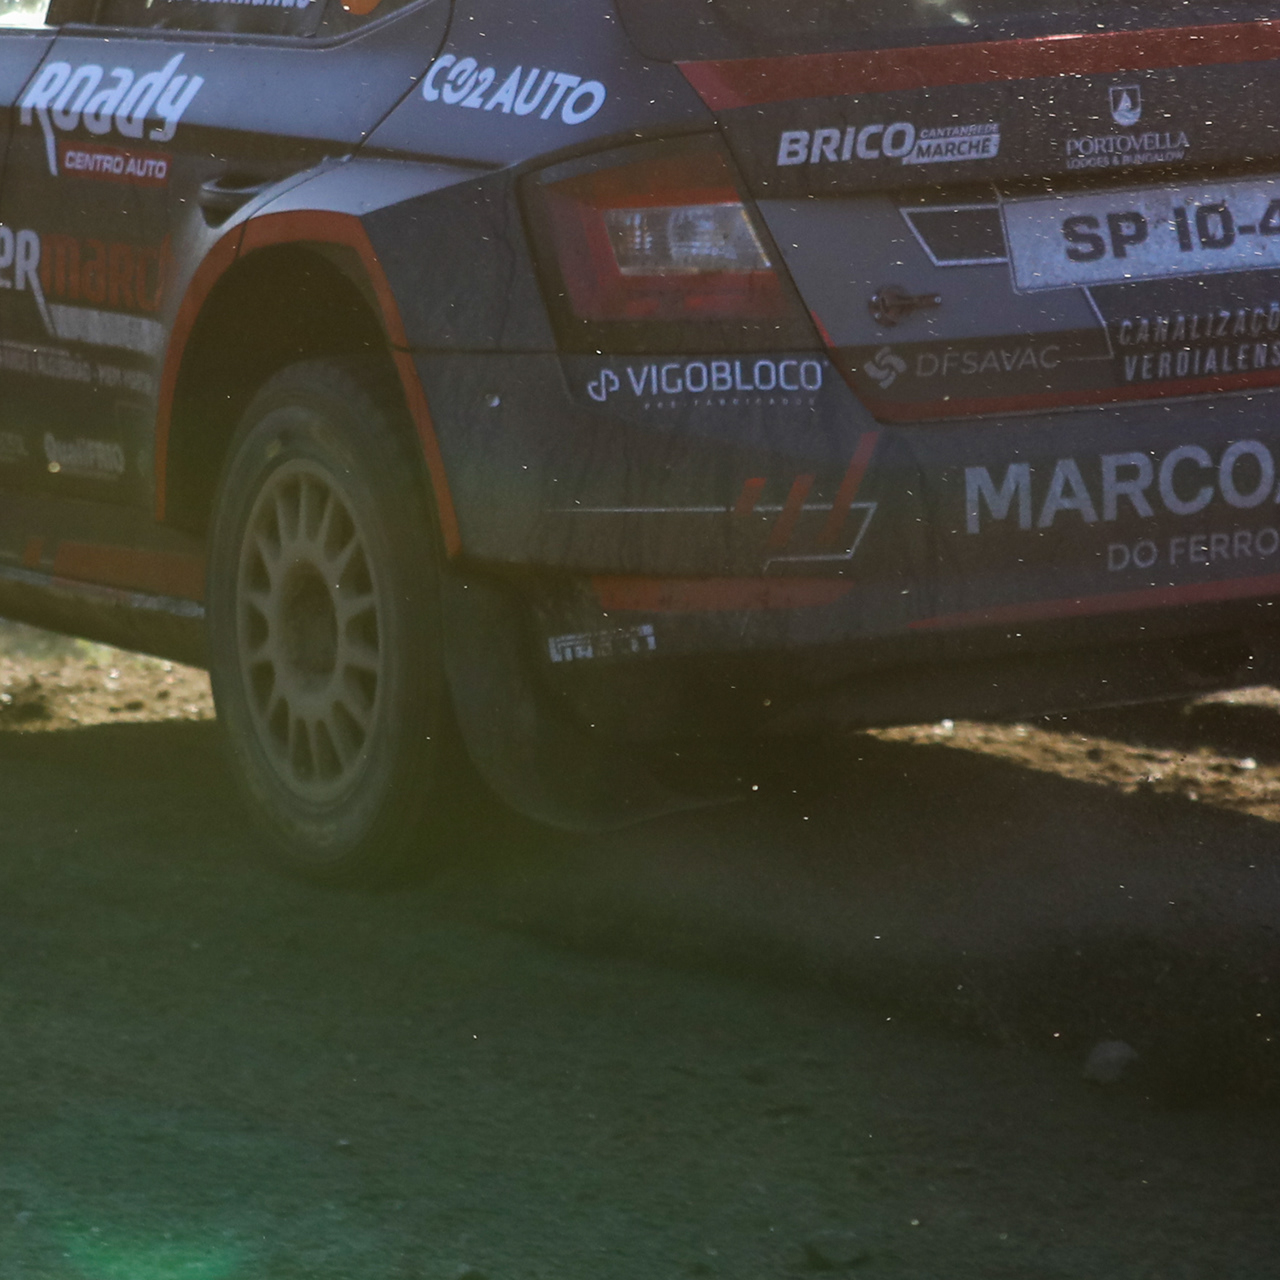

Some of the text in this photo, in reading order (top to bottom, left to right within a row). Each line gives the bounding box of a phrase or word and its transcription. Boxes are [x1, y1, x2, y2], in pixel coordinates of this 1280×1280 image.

[776, 120, 918, 167] BRICO
[1065, 130, 1190, 157] PORTOVELLA
[1066, 155, 1110, 170] LODGES
[64, 151, 168, 180] CENTRO AUTO
[1061, 211, 1149, 263] SP
[627, 358, 824, 398] VIGOBLOCO
[1107, 541, 1159, 572] DO
[1169, 526, 1280, 566] FERRO
